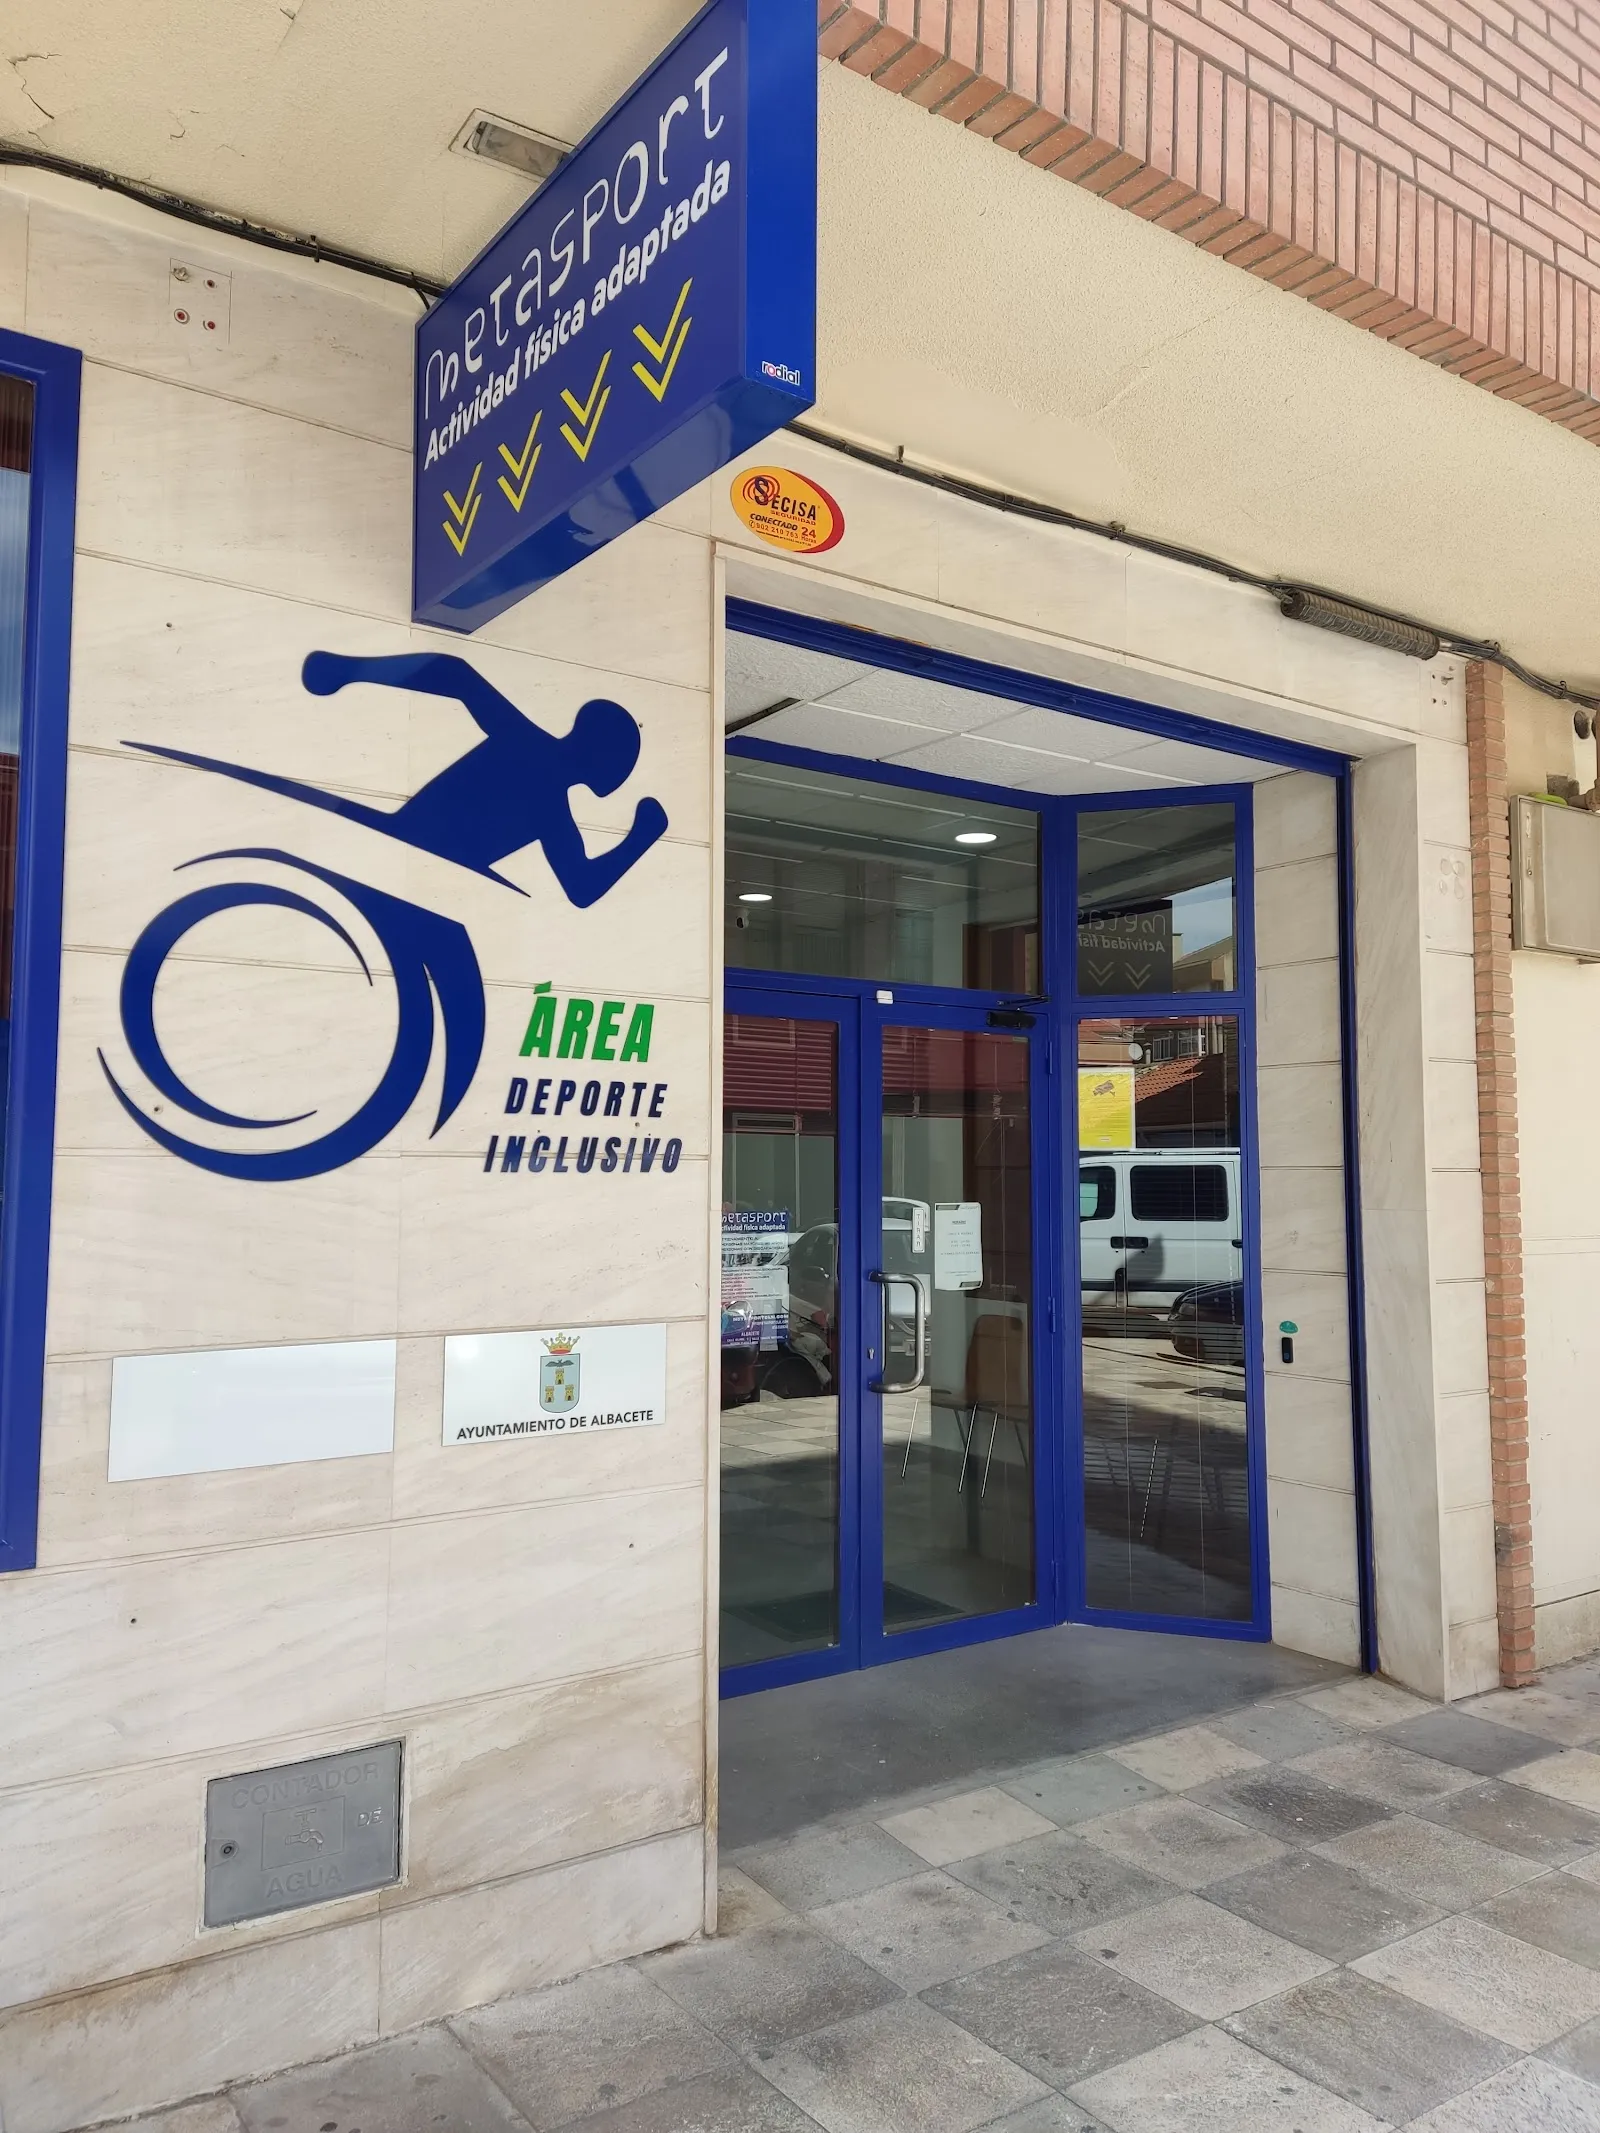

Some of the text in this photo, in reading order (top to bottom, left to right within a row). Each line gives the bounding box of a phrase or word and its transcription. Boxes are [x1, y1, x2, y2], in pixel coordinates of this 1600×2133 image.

[424, 159, 731, 471] Actividad física adaptada
[761, 360, 801, 386] rodial
[752, 476, 817, 521] SECISA
[749, 513, 798, 531] CONECTADO
[801, 526, 817, 539] 24
[770, 509, 817, 526] SEGURIDAD
[519, 980, 655, 1063] ÁREA
[504, 1077, 668, 1118] DEPORTE
[483, 1135, 683, 1174] INCLUSIVO
[457, 1409, 654, 1440] AYUNTAMIENTO DE ALBACETE
[231, 1761, 380, 1810] CONTADOR
[356, 1806, 384, 1828] DE
[266, 1865, 343, 1899] AGUA
